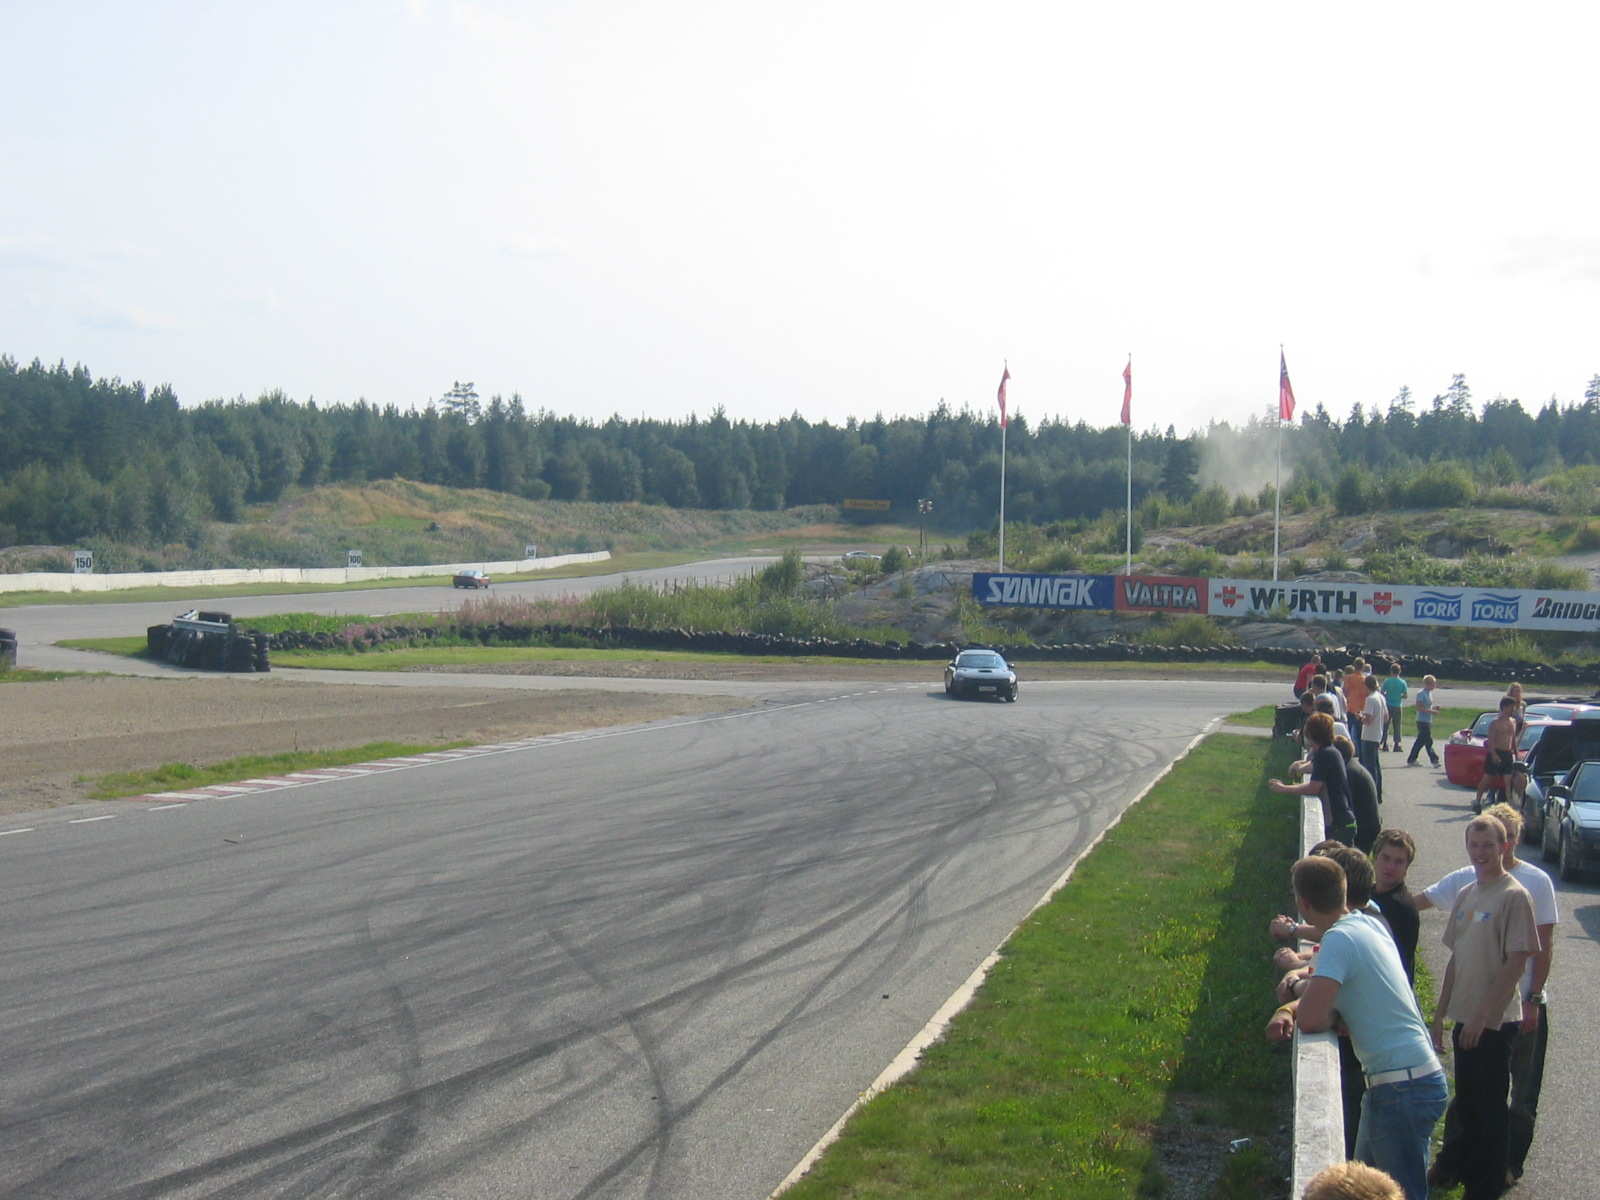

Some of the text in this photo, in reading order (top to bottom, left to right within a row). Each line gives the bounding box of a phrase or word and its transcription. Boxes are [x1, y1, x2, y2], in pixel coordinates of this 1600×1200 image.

[75, 557, 92, 568] 150
[1123, 580, 1200, 609] VALTRA
[1416, 602, 1459, 617] TORK
[1474, 604, 1516, 619] TORK
